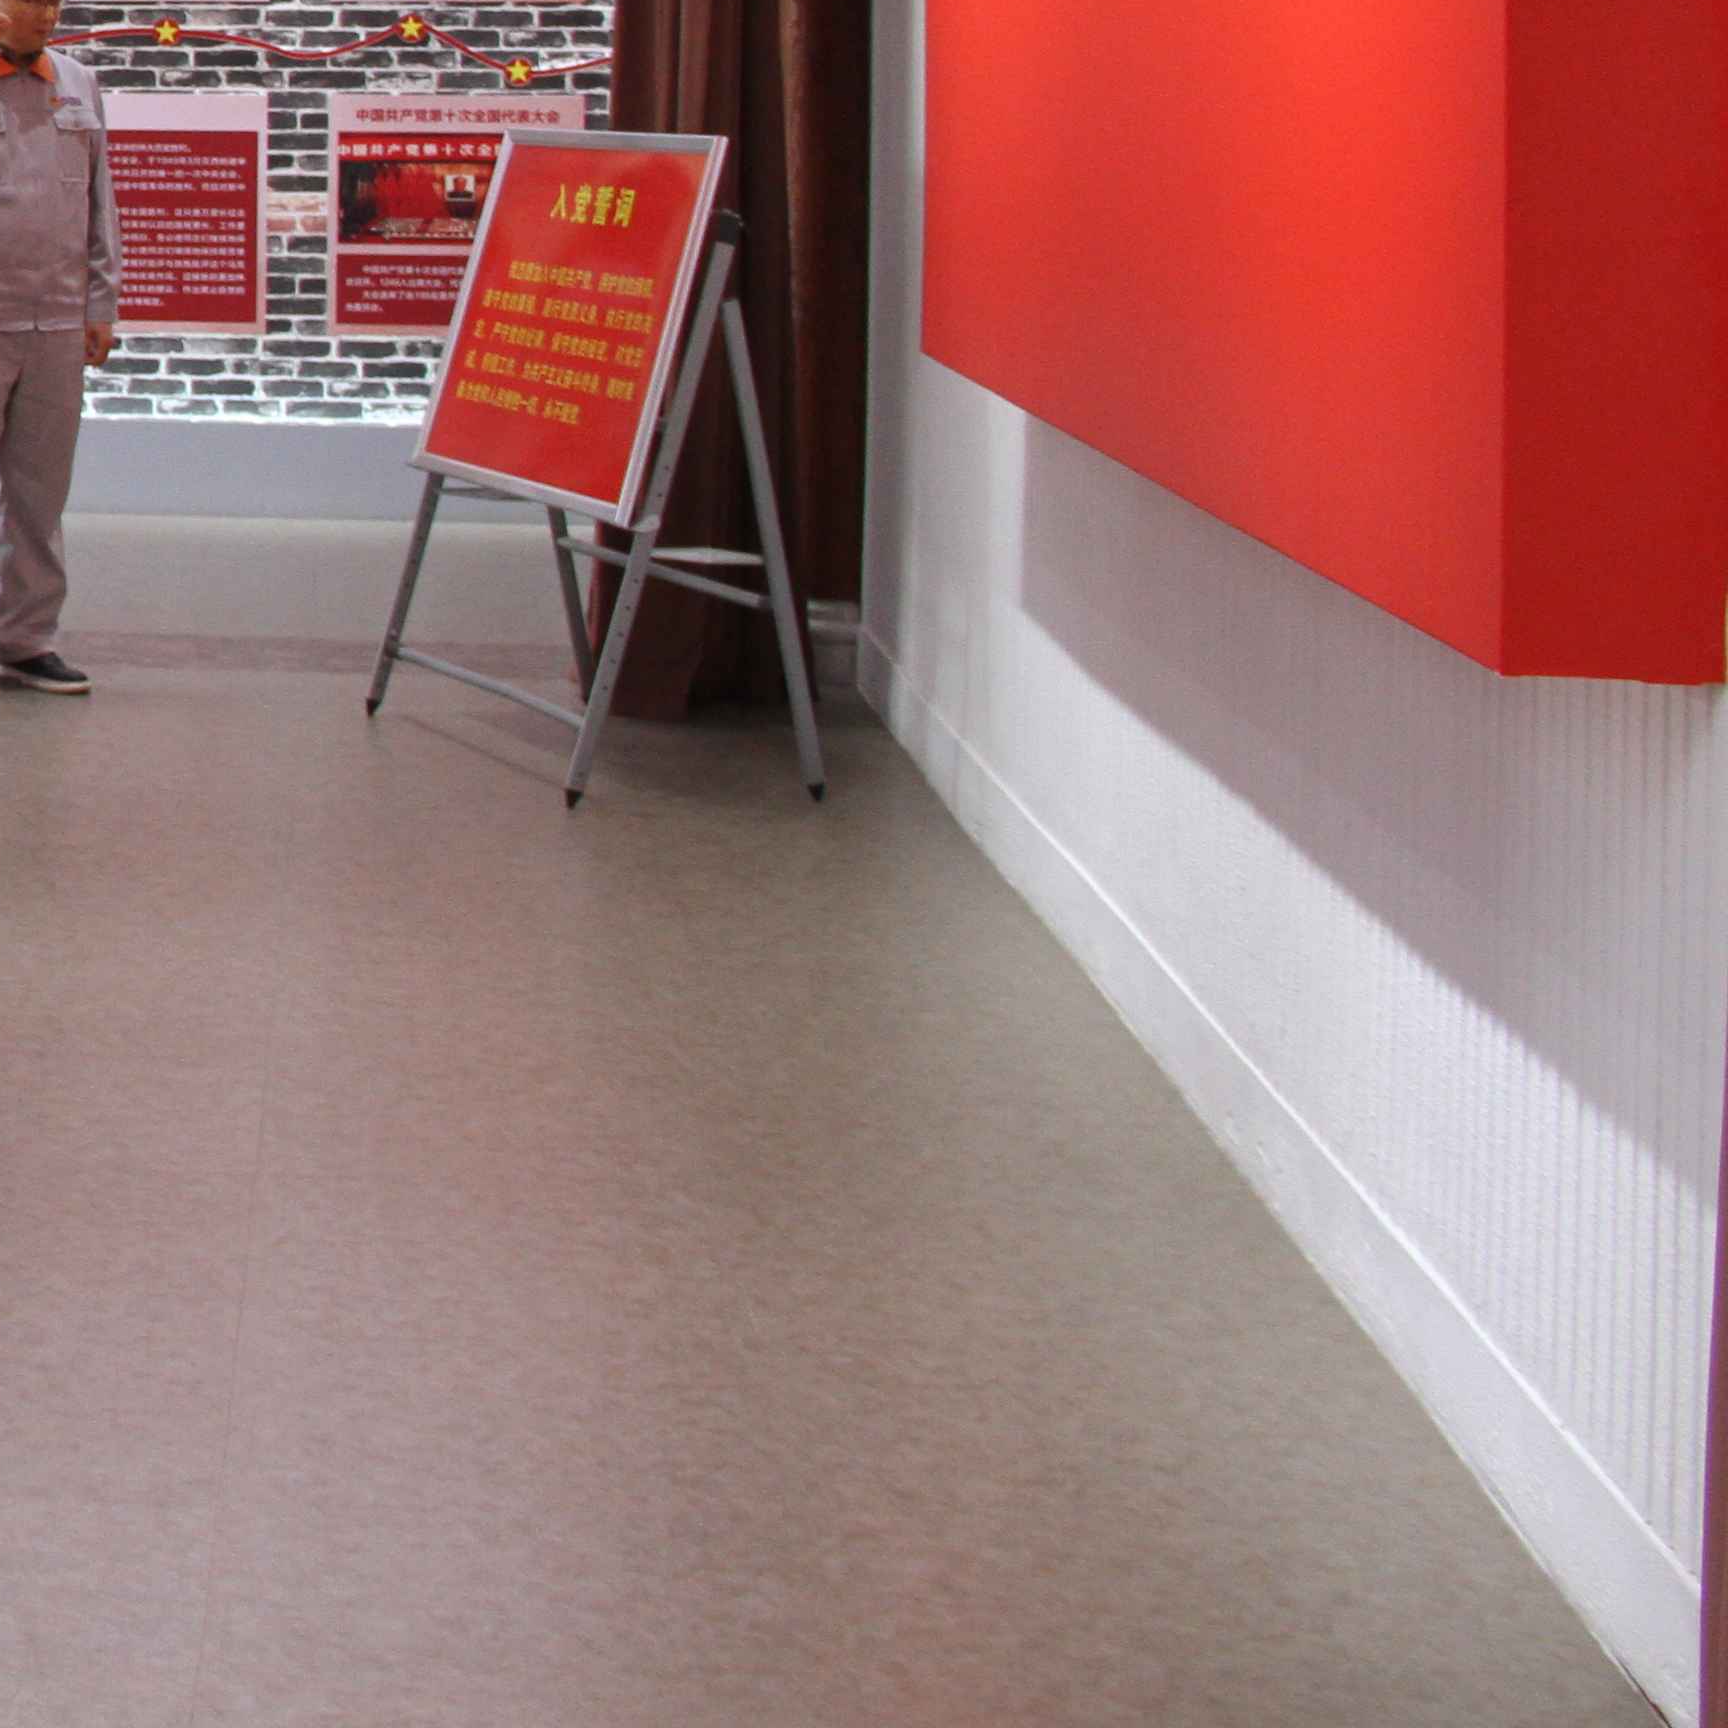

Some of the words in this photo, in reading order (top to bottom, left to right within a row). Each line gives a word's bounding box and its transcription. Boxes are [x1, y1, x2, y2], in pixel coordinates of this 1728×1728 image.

[356, 108, 561, 124] 中国共产党第十次全国代表大会
[337, 143, 501, 157] 中国共产党第十次全
[549, 183, 636, 228] 入党誓词
